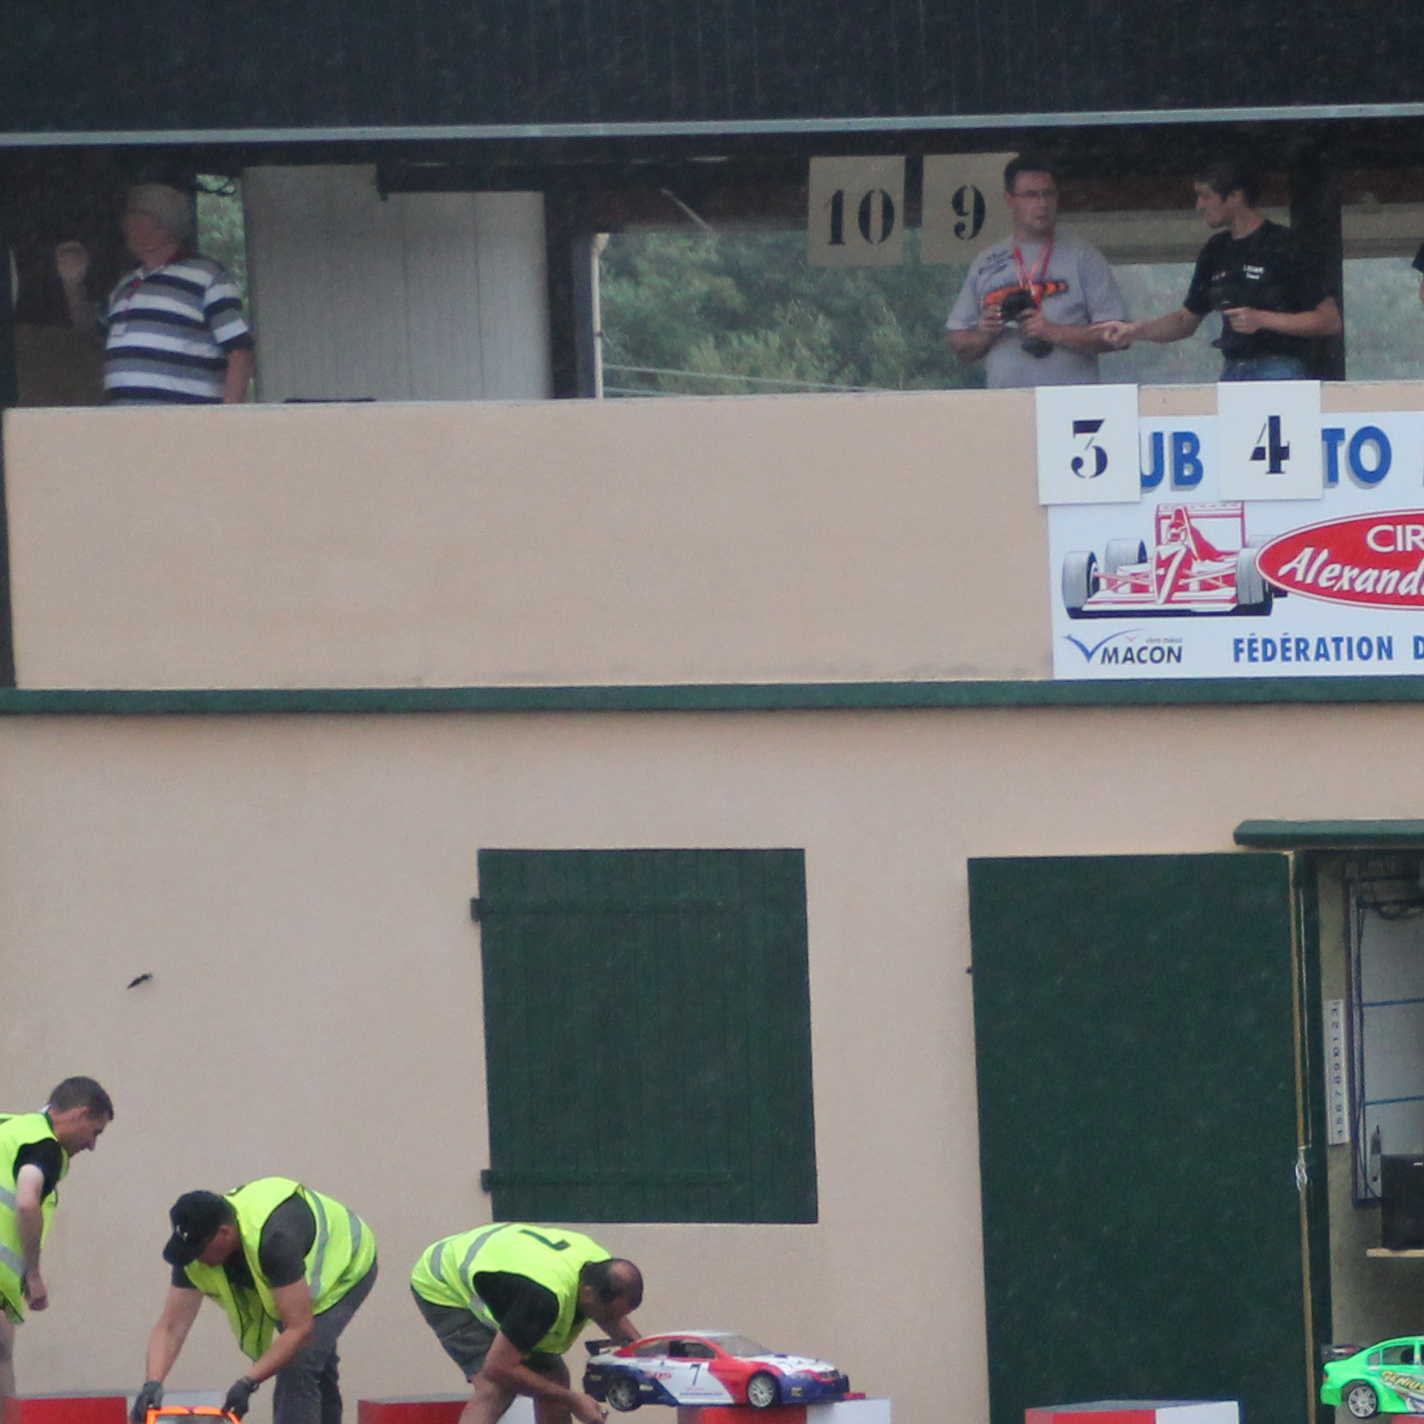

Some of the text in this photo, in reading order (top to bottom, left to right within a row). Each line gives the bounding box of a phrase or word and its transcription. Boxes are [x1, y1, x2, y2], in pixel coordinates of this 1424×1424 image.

[825, 189, 895, 246] 10
[951, 185, 986, 241] 9
[1070, 419, 1108, 479] 3
[1249, 415, 1290, 475] 4
[1101, 645, 1183, 665] MACON
[1233, 632, 1394, 663] FÉDÉRATION
[690, 1363, 702, 1387] 7
